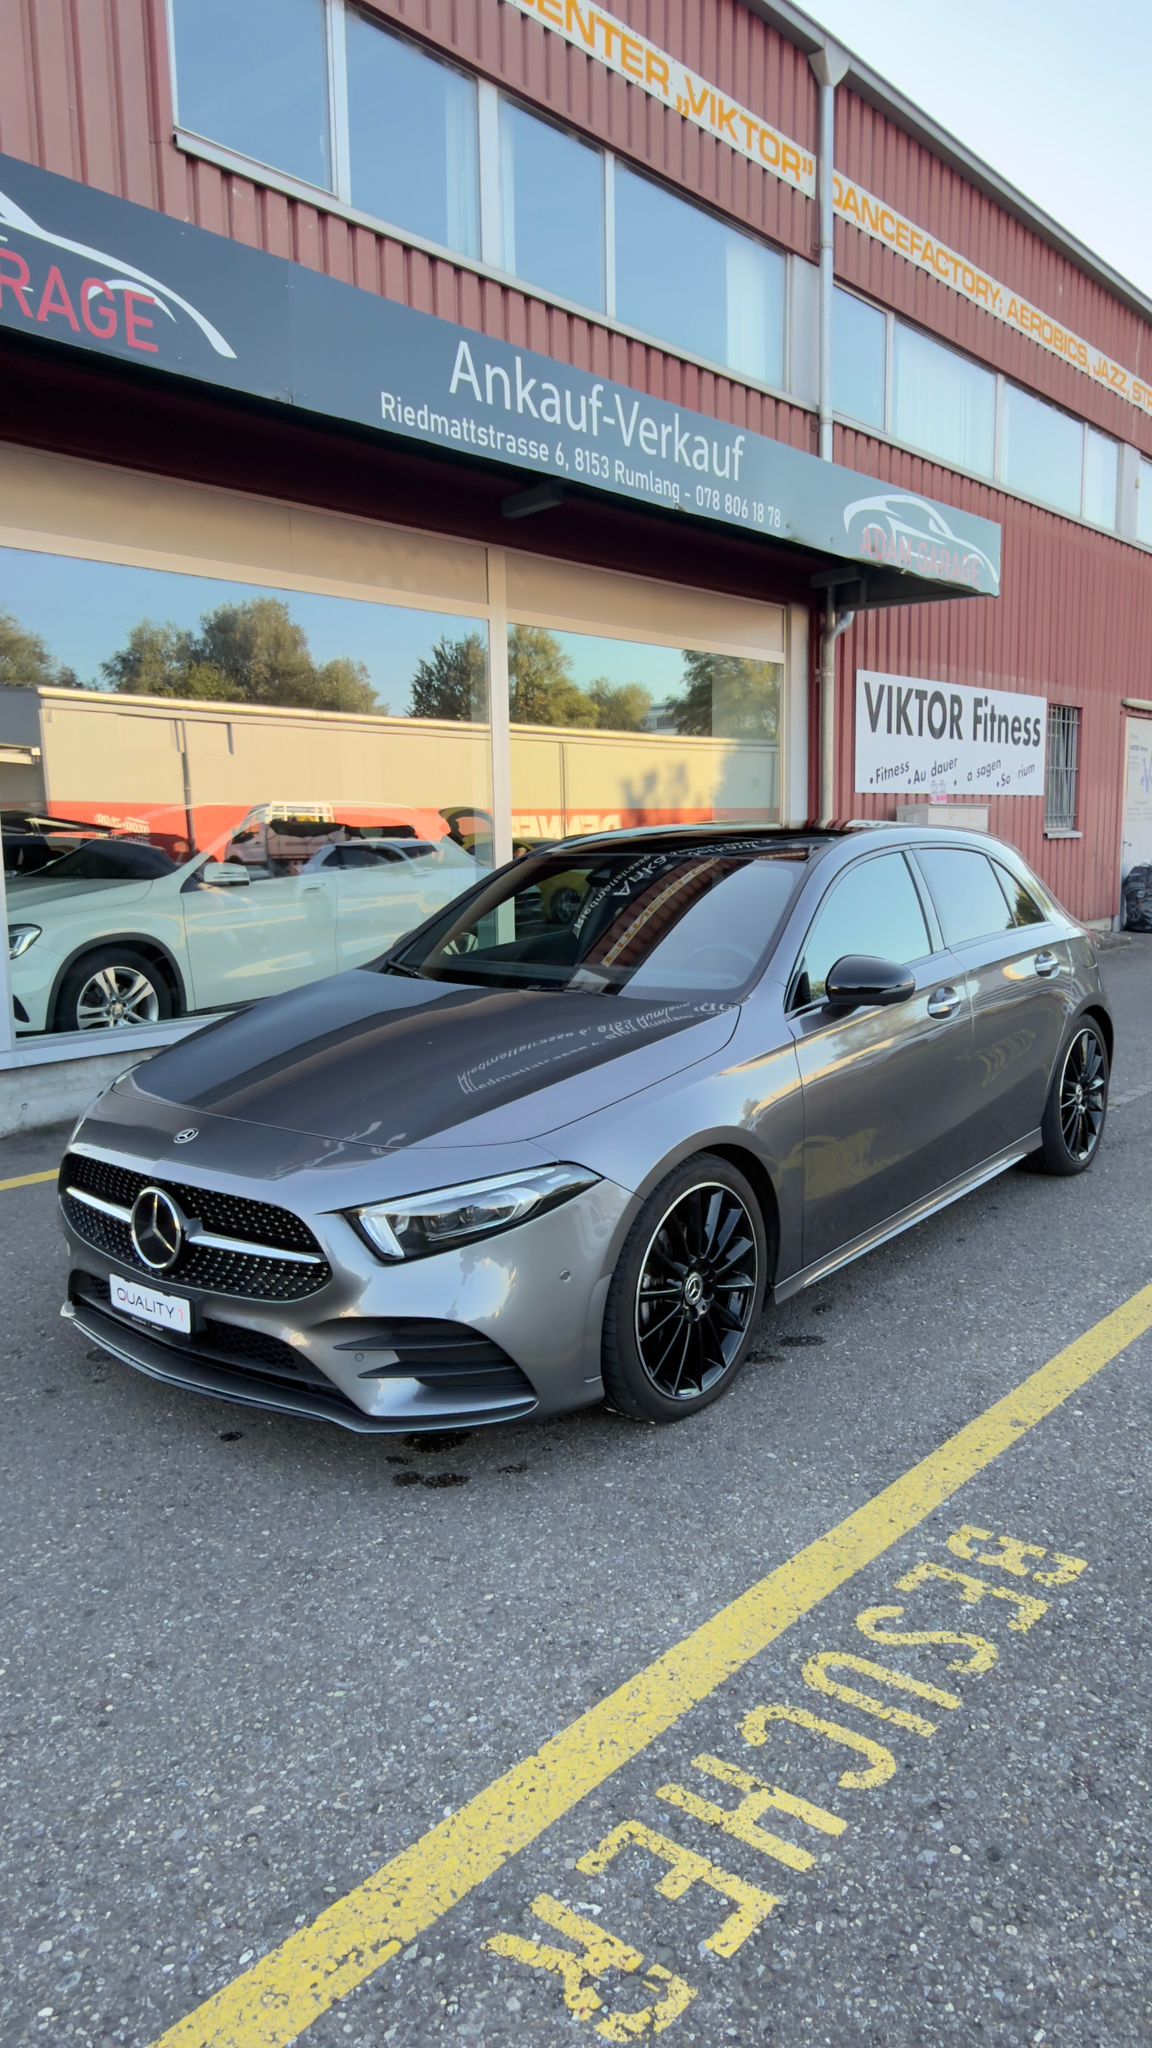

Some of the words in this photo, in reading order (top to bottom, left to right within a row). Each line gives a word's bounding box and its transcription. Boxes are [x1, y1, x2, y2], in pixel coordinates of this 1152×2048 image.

[380, 391, 549, 462] Riedmattstrasse
[555, 441, 569, 472] 6,
[575, 447, 610, 479] 8153
[614, 460, 680, 504] Rumlang
[696, 485, 721, 511] 078
[725, 494, 749, 519] 806
[753, 501, 764, 523] 18
[768, 506, 781, 529] 78
[449, 340, 745, 481] Ankauf-Verkauf
[864, 681, 963, 740] VIKTOR
[973, 696, 1041, 747] Fitness
[116, 1287, 174, 1319] QUALITY
[178, 1307, 184, 1322] 1
[481, 1524, 1088, 2043] BESUCHER
